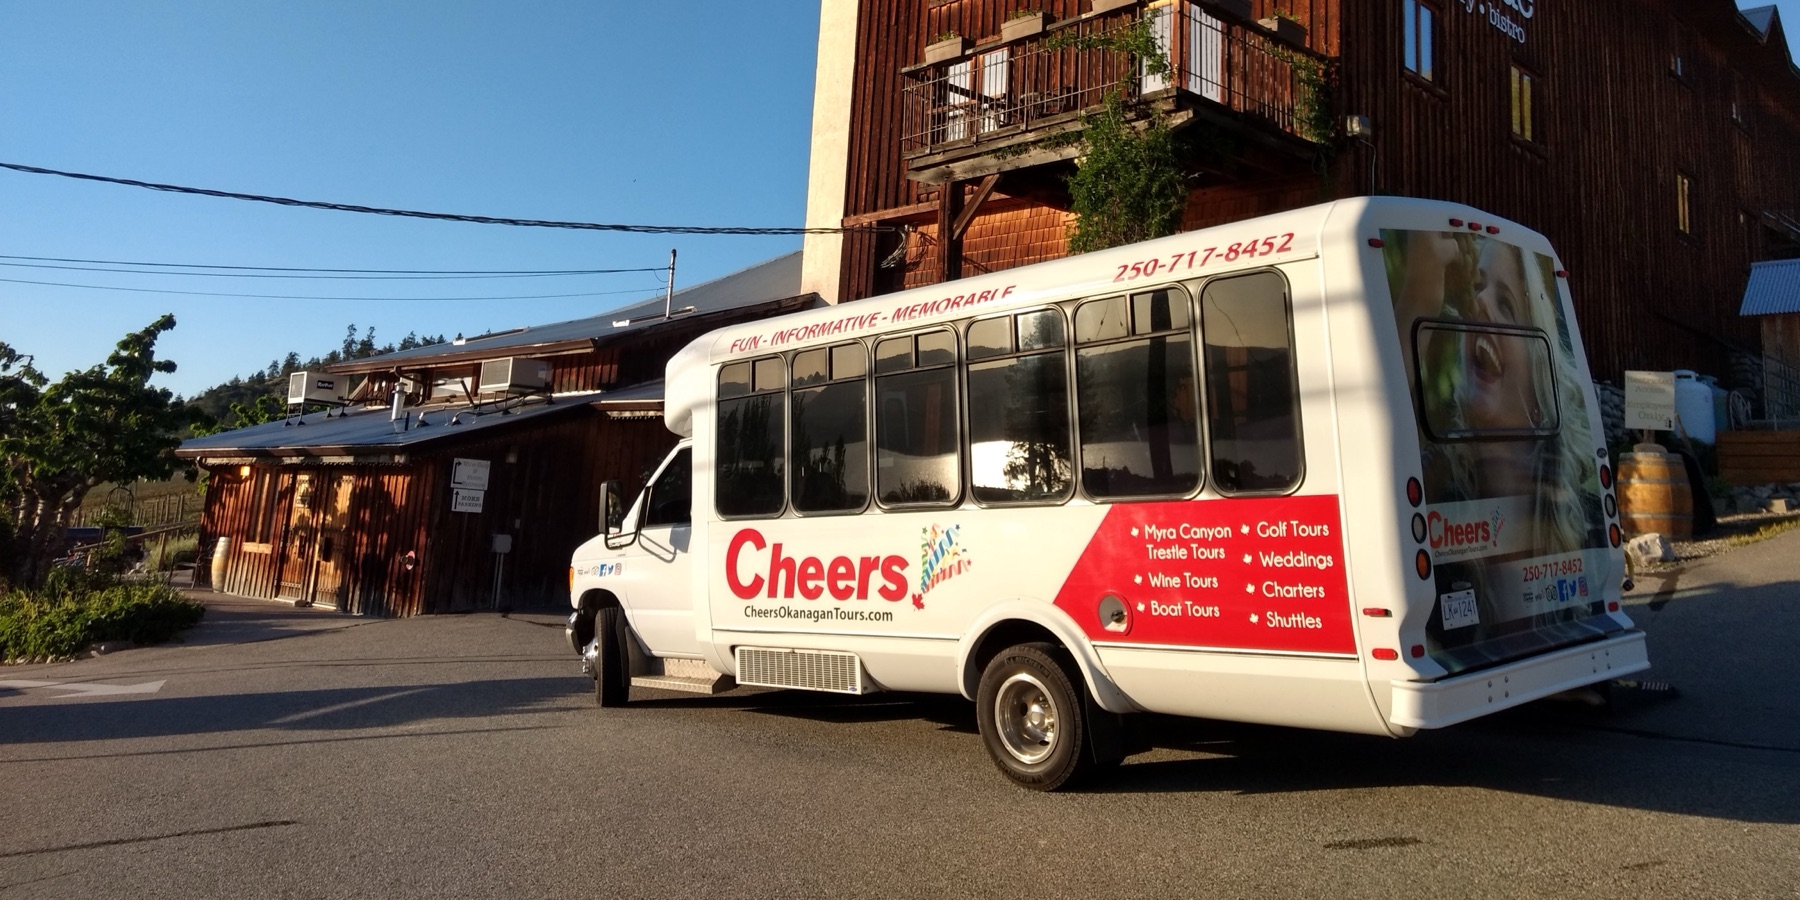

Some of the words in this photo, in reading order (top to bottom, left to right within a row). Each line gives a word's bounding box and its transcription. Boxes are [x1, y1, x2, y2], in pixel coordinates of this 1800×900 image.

[1488, 1, 1526, 44] bistro
[1113, 232, 1295, 283] 250-717-8452
[729, 336, 762, 354] FUN
[770, 312, 882, 347] INFORMATIVE
[891, 285, 1017, 324] MEMORABLE
[1638, 410, 1665, 422] Only
[1144, 524, 1177, 542] Myra
[1179, 522, 1233, 542] Canyon
[1256, 521, 1288, 539] Golf
[1290, 520, 1330, 537] Tours
[1427, 510, 1491, 549] Cheers
[1146, 544, 1188, 560] Trestle
[1190, 543, 1226, 560] Tours
[1259, 550, 1334, 570] Weddings
[725, 527, 910, 602] Cheers
[1522, 557, 1583, 583] 250-717-8452
[1148, 572, 1181, 588] Wine
[1183, 572, 1219, 588] Tours
[1262, 580, 1326, 599] Charters
[744, 605, 893, 623] CheersOkanaganTours.com
[1150, 600, 1182, 617] Boat
[1184, 600, 1220, 618] Tours
[1266, 611, 1323, 629] Shuttles
[1015, 656, 1051, 678] MICHELIN
